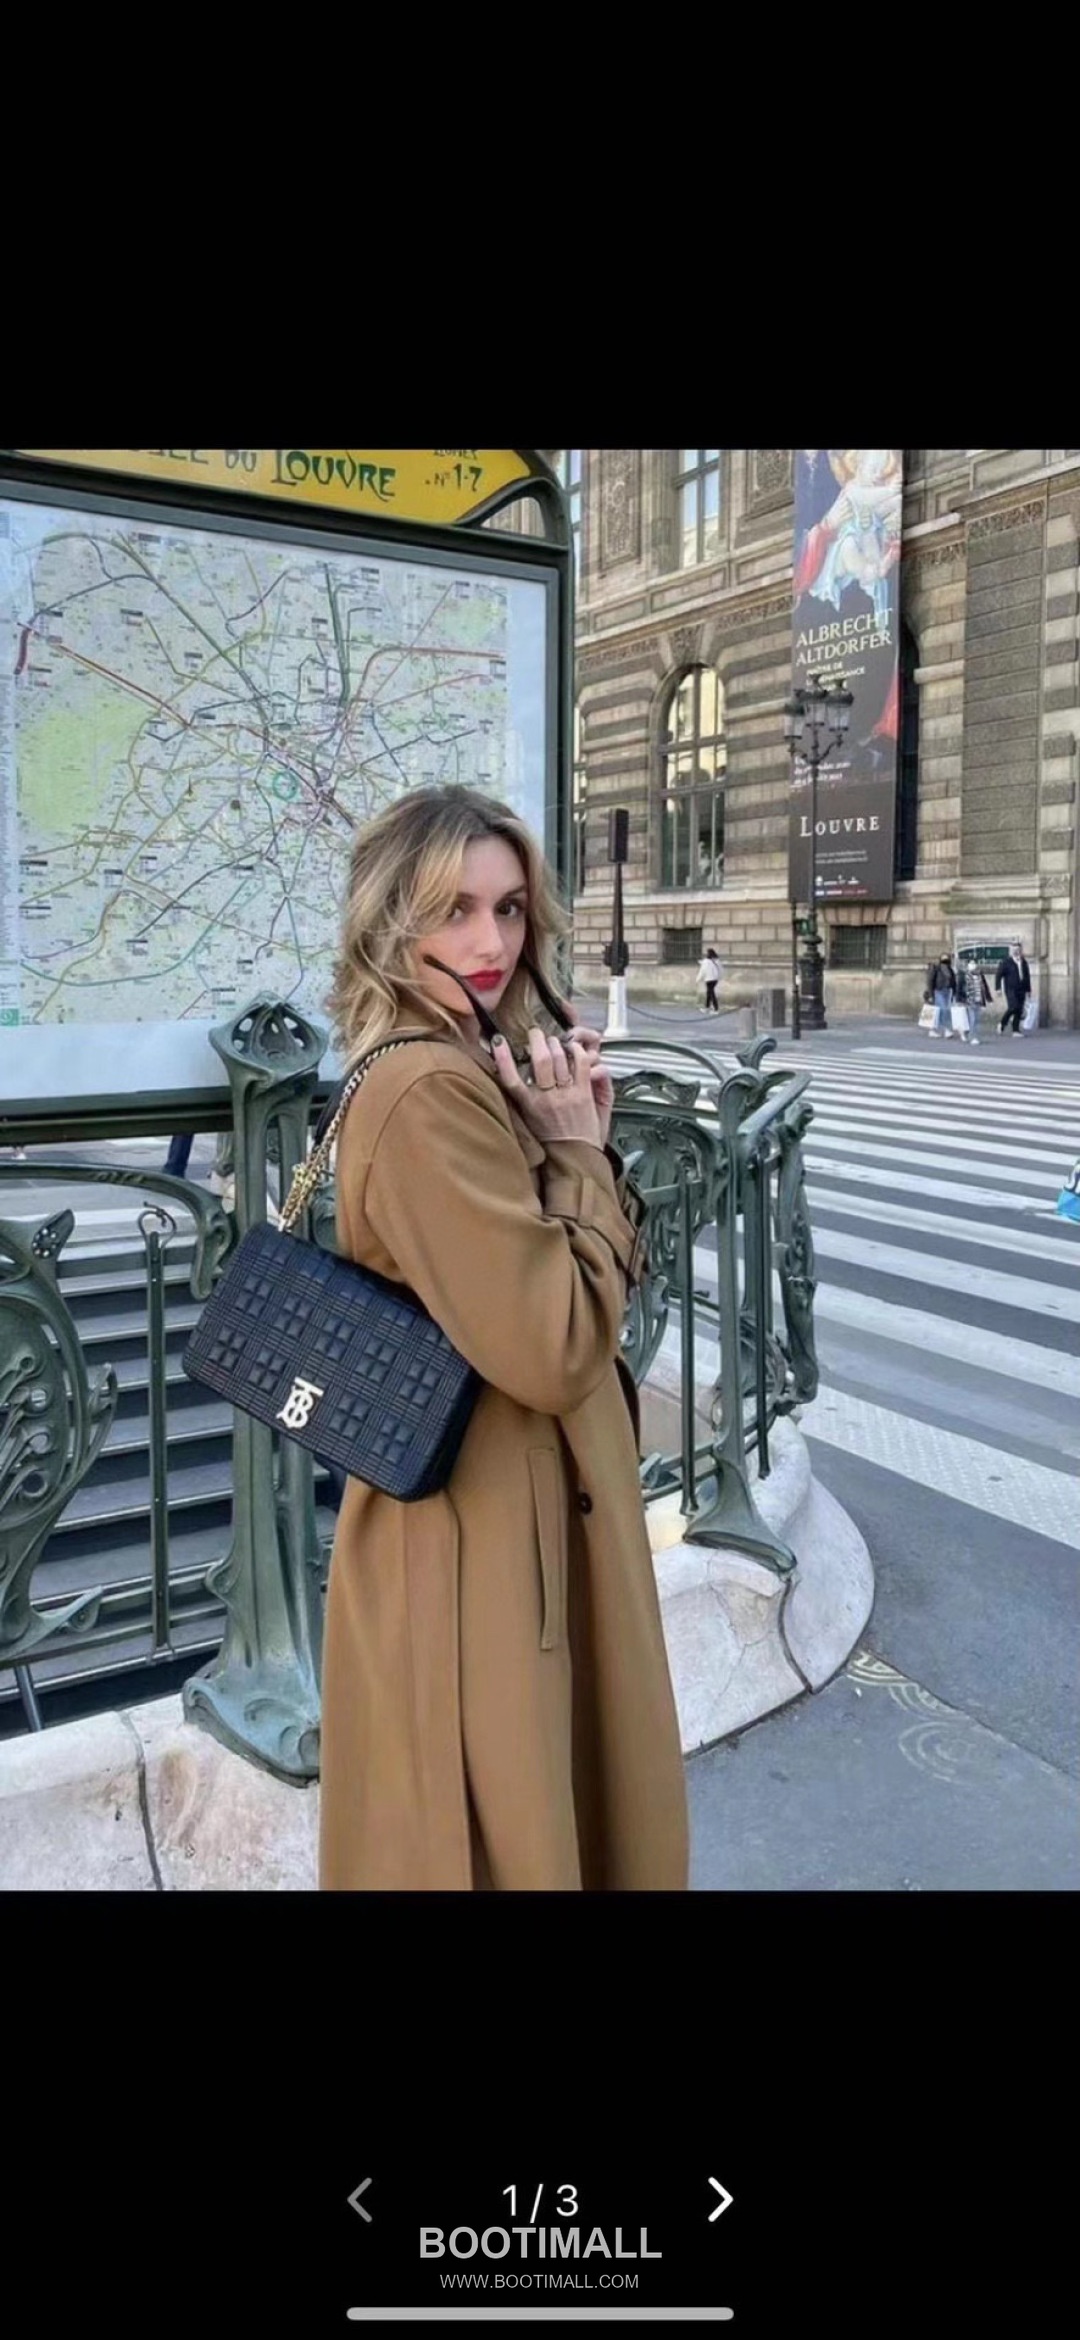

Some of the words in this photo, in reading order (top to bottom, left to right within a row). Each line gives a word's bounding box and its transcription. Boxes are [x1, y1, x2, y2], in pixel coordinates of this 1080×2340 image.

[271, 450, 396, 502] LOUVRE
[796, 608, 893, 648] ALBRECHT
[796, 630, 892, 667] ALTDORFER
[800, 816, 880, 837] LOUVRE
